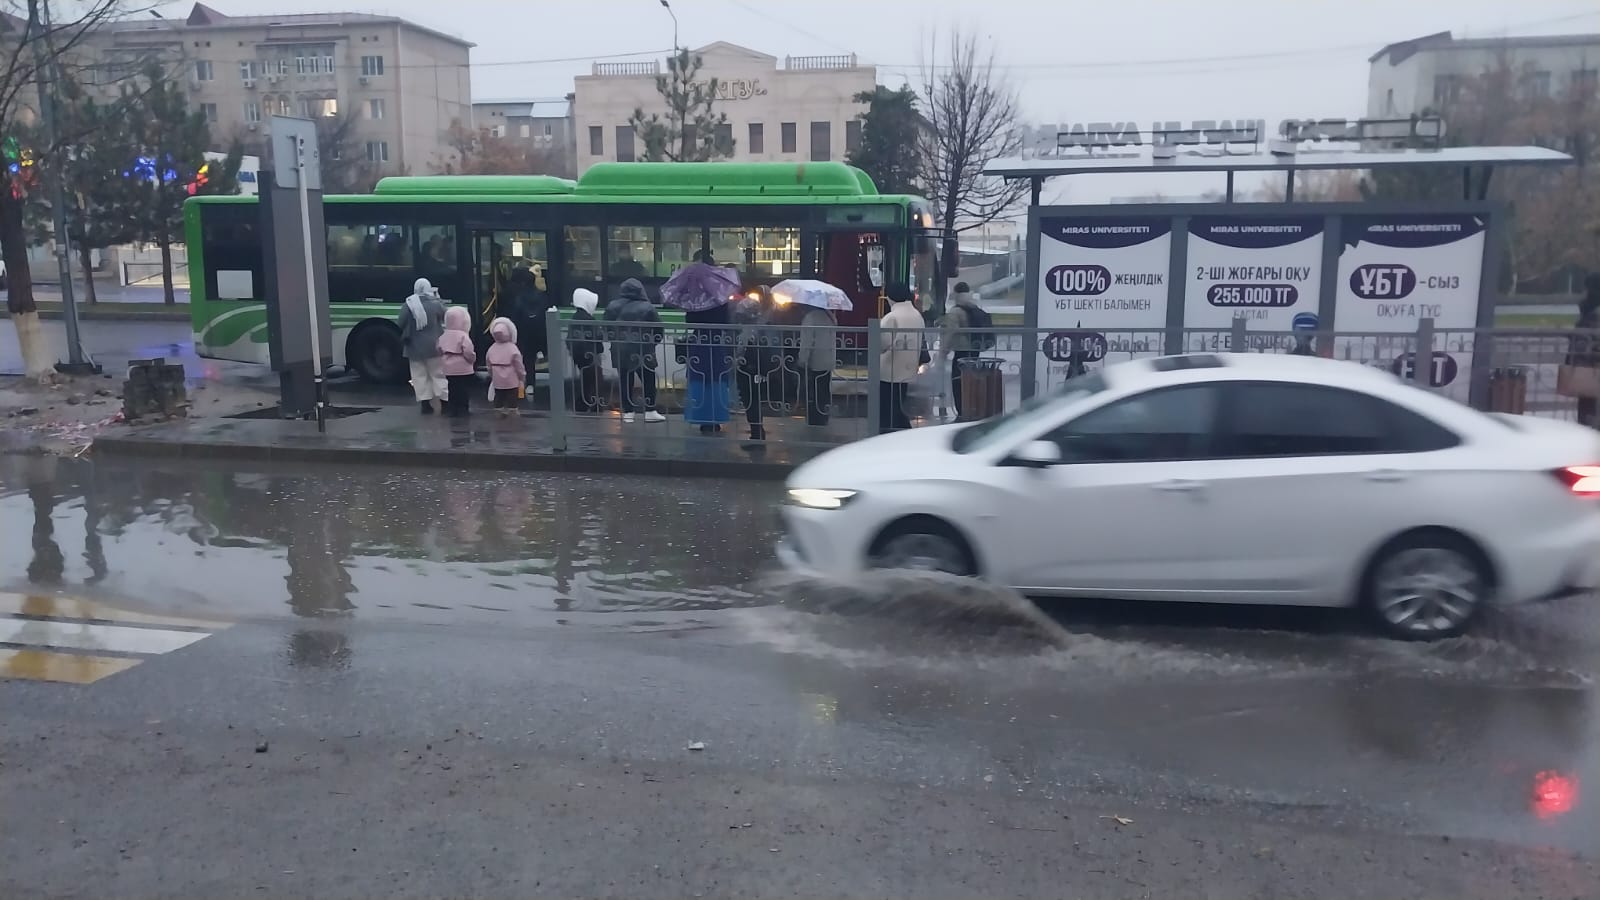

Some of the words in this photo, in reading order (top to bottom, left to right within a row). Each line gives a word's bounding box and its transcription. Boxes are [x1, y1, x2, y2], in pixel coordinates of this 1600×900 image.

[1062, 226, 1090, 234] MIRAS
[1091, 226, 1150, 234] UNIVERSITETI
[1241, 225, 1302, 233] UNIVERSITETI
[1396, 224, 1461, 232] UNIVERSITETI
[1053, 269, 1106, 292] 100%
[1196, 266, 1225, 280] 2-ШІ
[1228, 266, 1282, 280] ЖОҒАРЫ
[1285, 266, 1311, 282] ОҚУ
[1359, 268, 1408, 295] ҰБТ
[1213, 287, 1272, 304] 255.000
[1275, 287, 1292, 304] ТГ
[1104, 299, 1151, 310] БАЛЫМЕН
[1046, 336, 1102, 359] 10%
